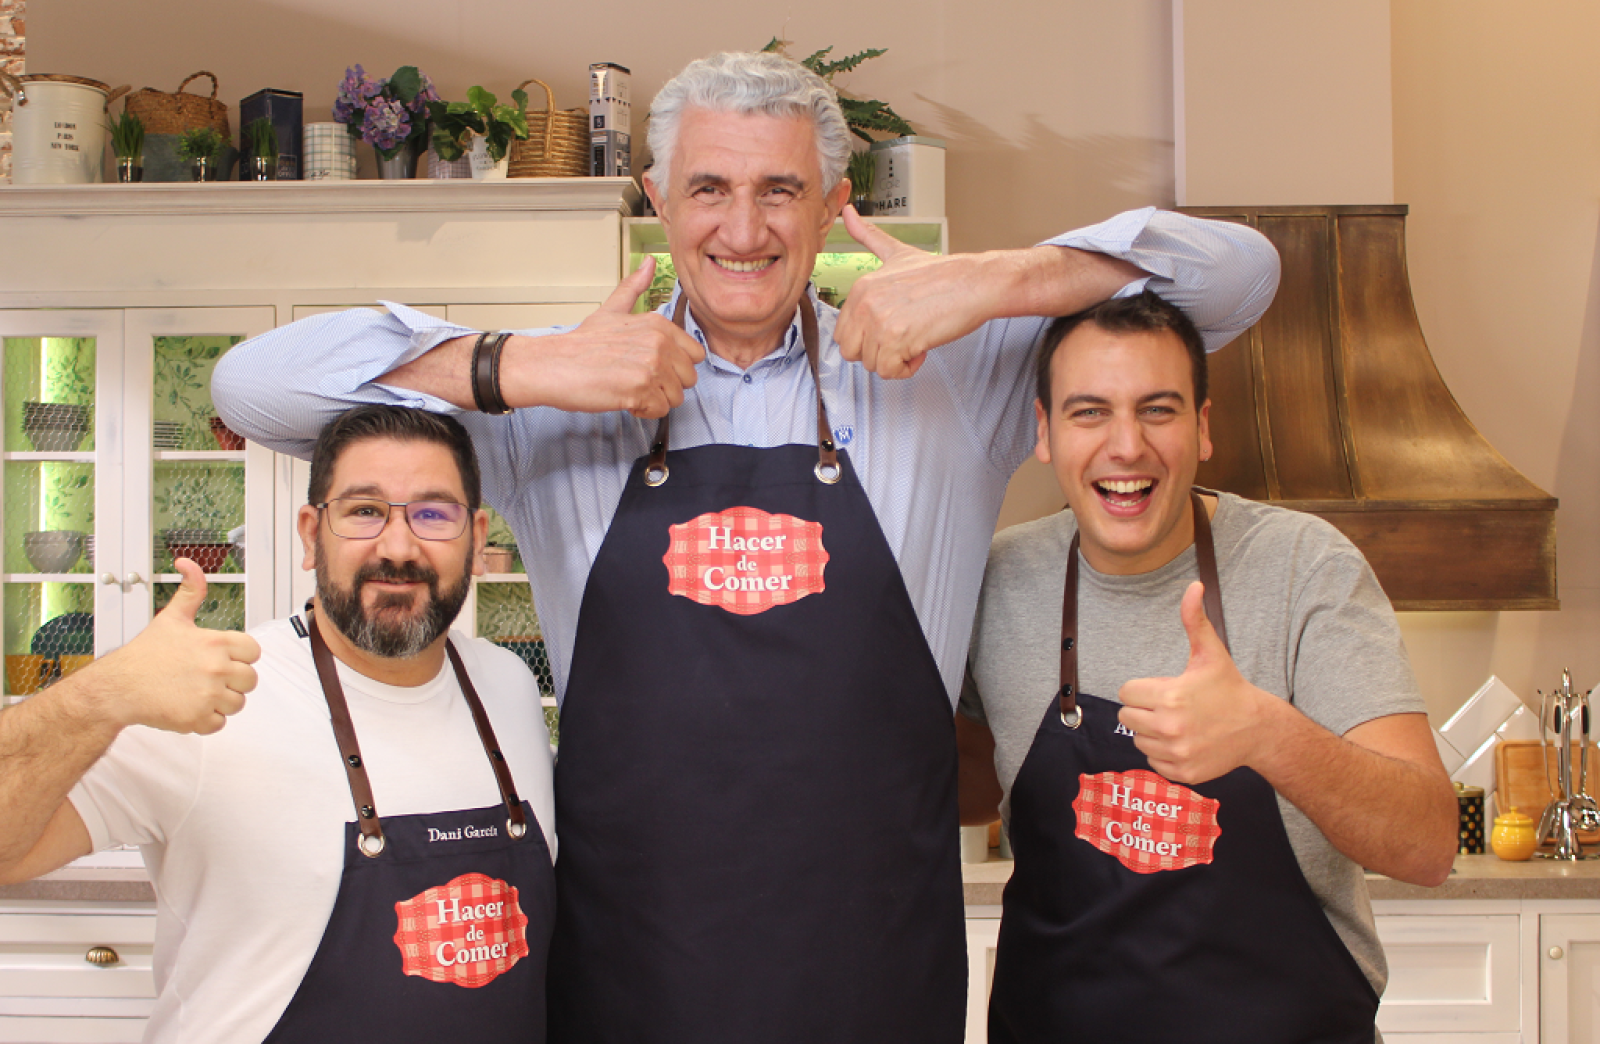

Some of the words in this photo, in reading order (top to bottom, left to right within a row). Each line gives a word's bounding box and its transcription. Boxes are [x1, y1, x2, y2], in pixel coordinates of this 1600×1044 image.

[707, 526, 787, 551] Hacer
[736, 555, 757, 571] de
[703, 566, 793, 591] Comer
[1110, 783, 1183, 819] Hacer
[427, 827, 463, 843] Dani
[1132, 816, 1151, 832] de
[1105, 821, 1183, 857] Comer
[436, 898, 504, 925] Hacer
[466, 924, 485, 942] de
[435, 941, 509, 967] Comer
